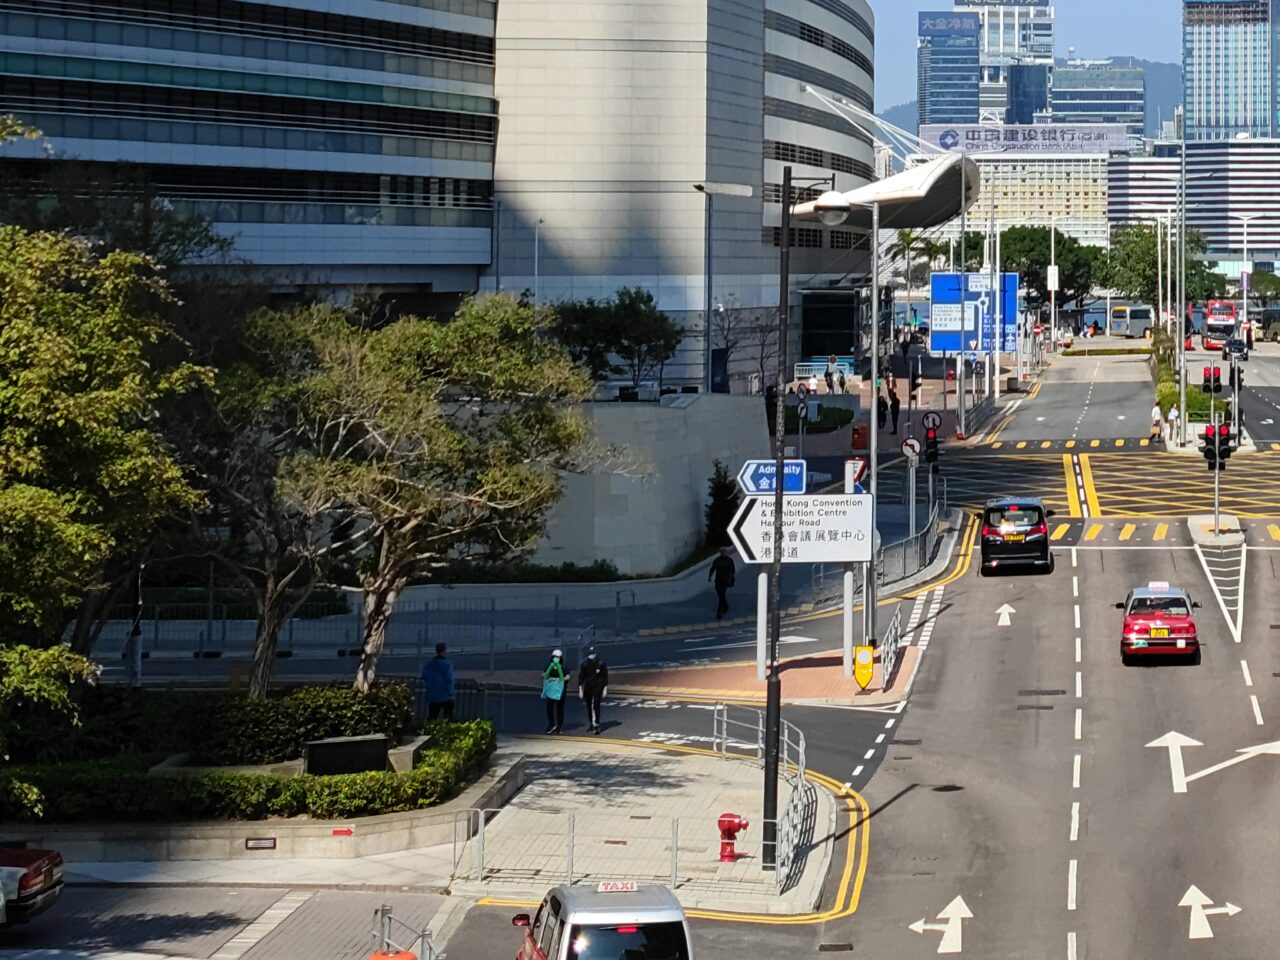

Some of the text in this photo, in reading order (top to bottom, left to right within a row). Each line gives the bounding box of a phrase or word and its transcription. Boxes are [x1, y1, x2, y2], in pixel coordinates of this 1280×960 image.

[758, 464, 801, 475] Admalty
[787, 499, 809, 509] Kong
[812, 498, 863, 507] Convention
[761, 509, 767, 517] &
[817, 509, 848, 517] Centre
[798, 518, 821, 527] Road
[760, 529, 865, 543] 香會議展覽中心
[760, 546, 798, 559] 港道
[602, 882, 635, 890] TAXI
